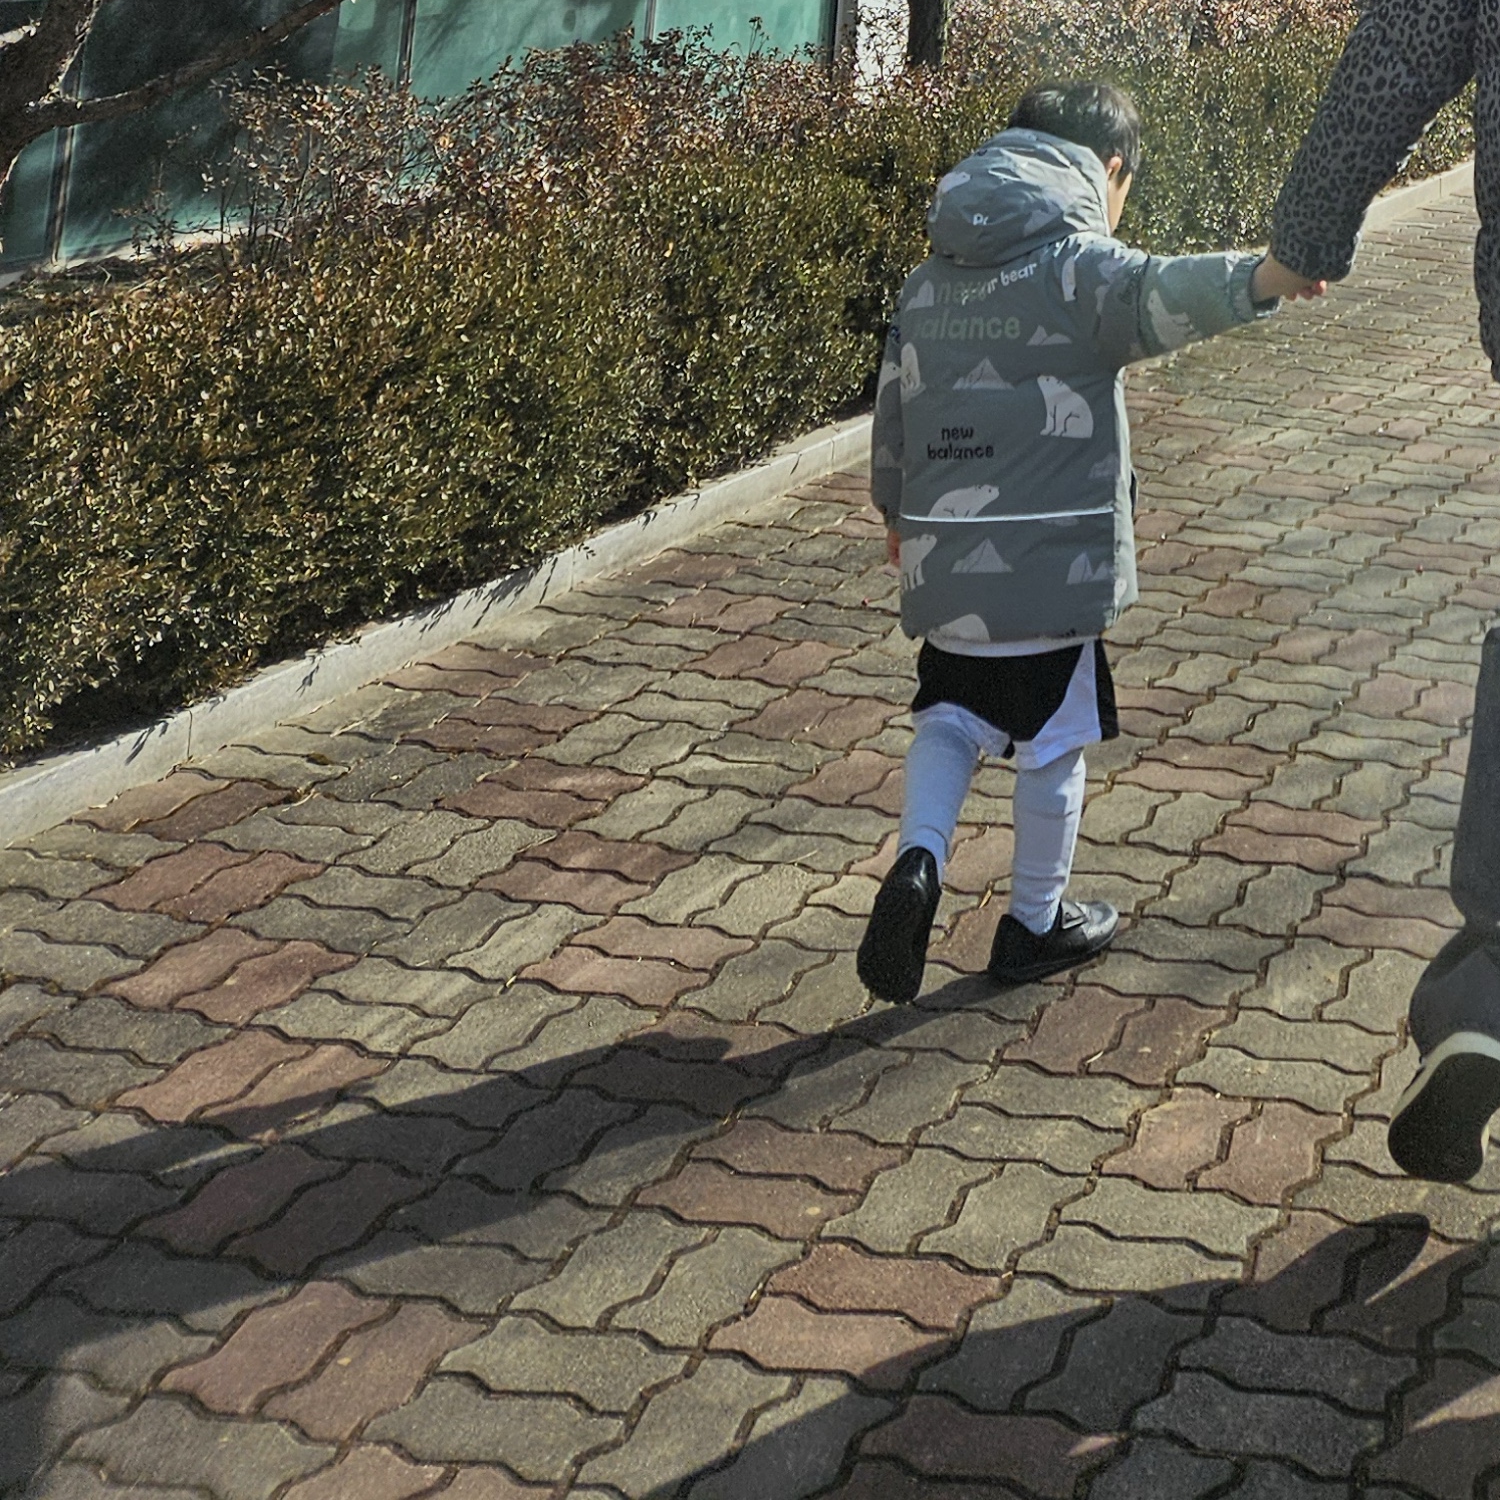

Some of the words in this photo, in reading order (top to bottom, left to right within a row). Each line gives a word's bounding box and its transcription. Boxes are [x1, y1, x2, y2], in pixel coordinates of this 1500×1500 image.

[1000, 262, 1037, 286] bear
[912, 308, 1021, 340] alance
[941, 426, 975, 441] new
[927, 443, 994, 460] balance
